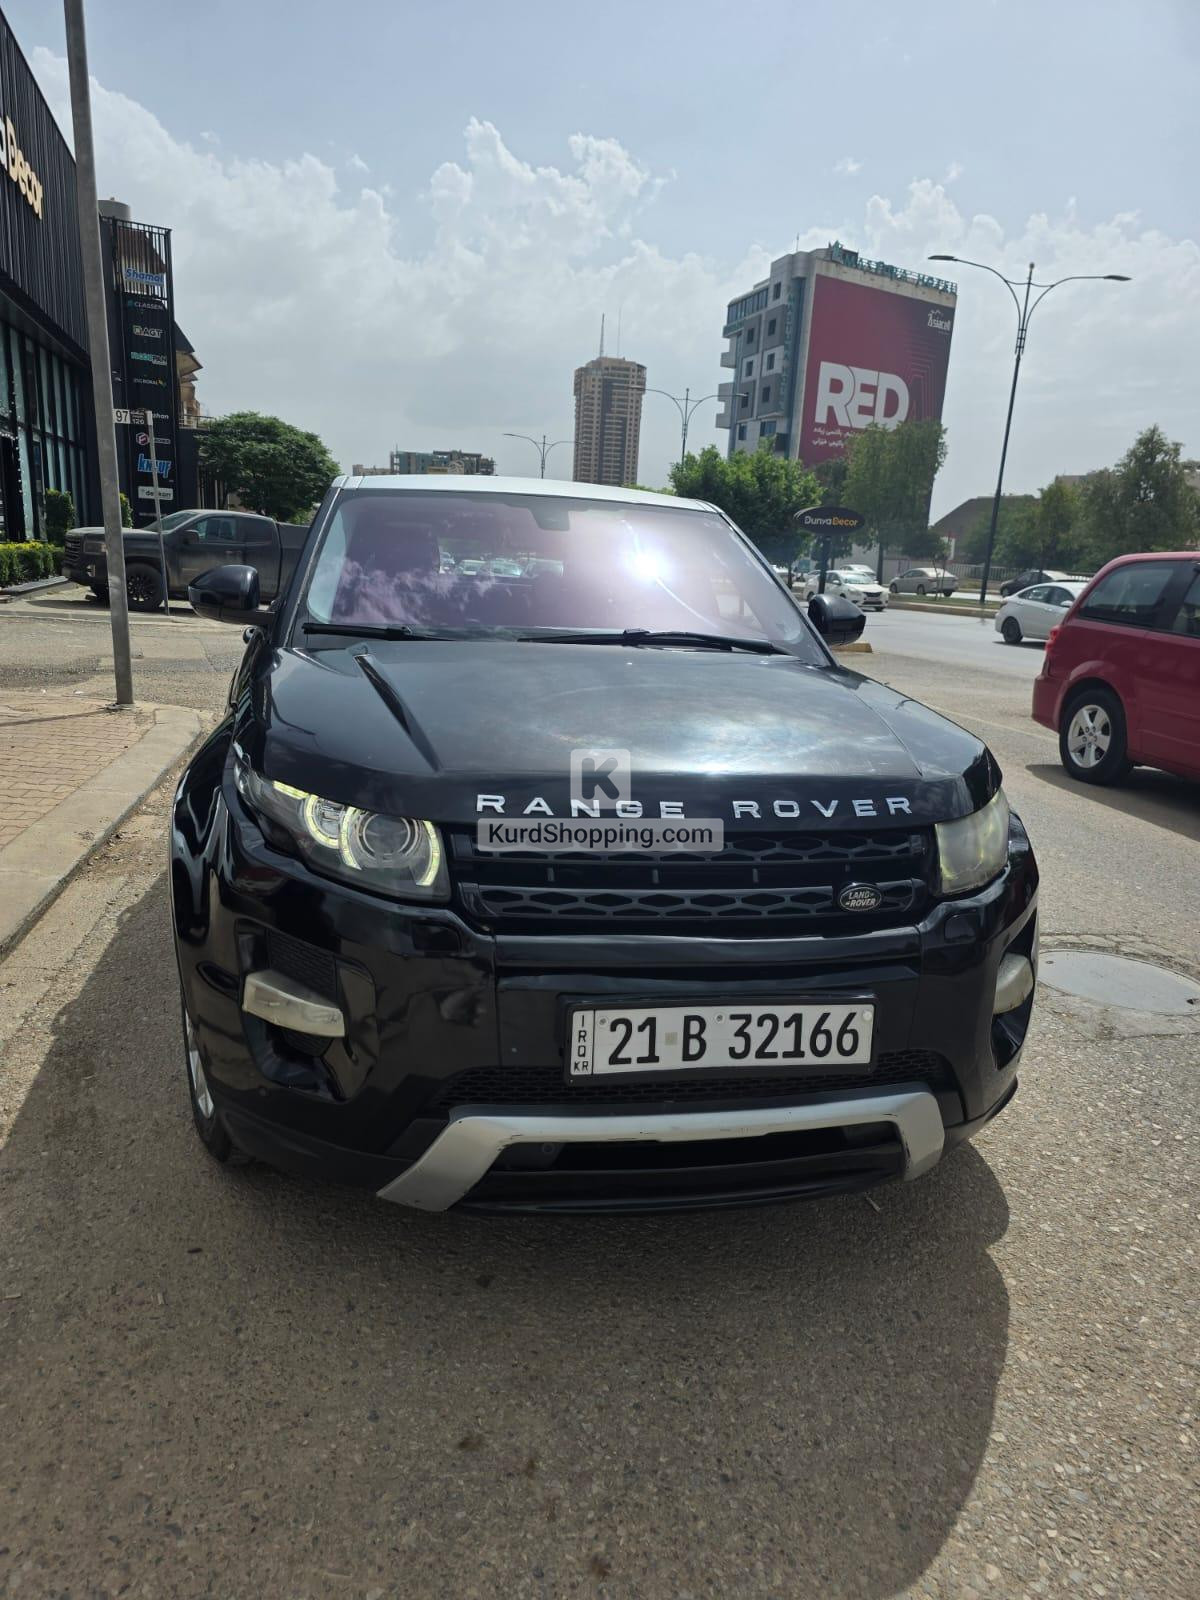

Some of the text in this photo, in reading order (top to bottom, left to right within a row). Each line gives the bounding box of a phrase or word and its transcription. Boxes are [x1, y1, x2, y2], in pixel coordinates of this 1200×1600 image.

[814, 360, 910, 431] RED
[115, 410, 129, 422] 97
[476, 793, 912, 819] RANGE ROVER
[849, 890, 870, 900] LAND
[850, 898, 876, 908] ROVER
[608, 1012, 860, 1066] 21 B 32166
